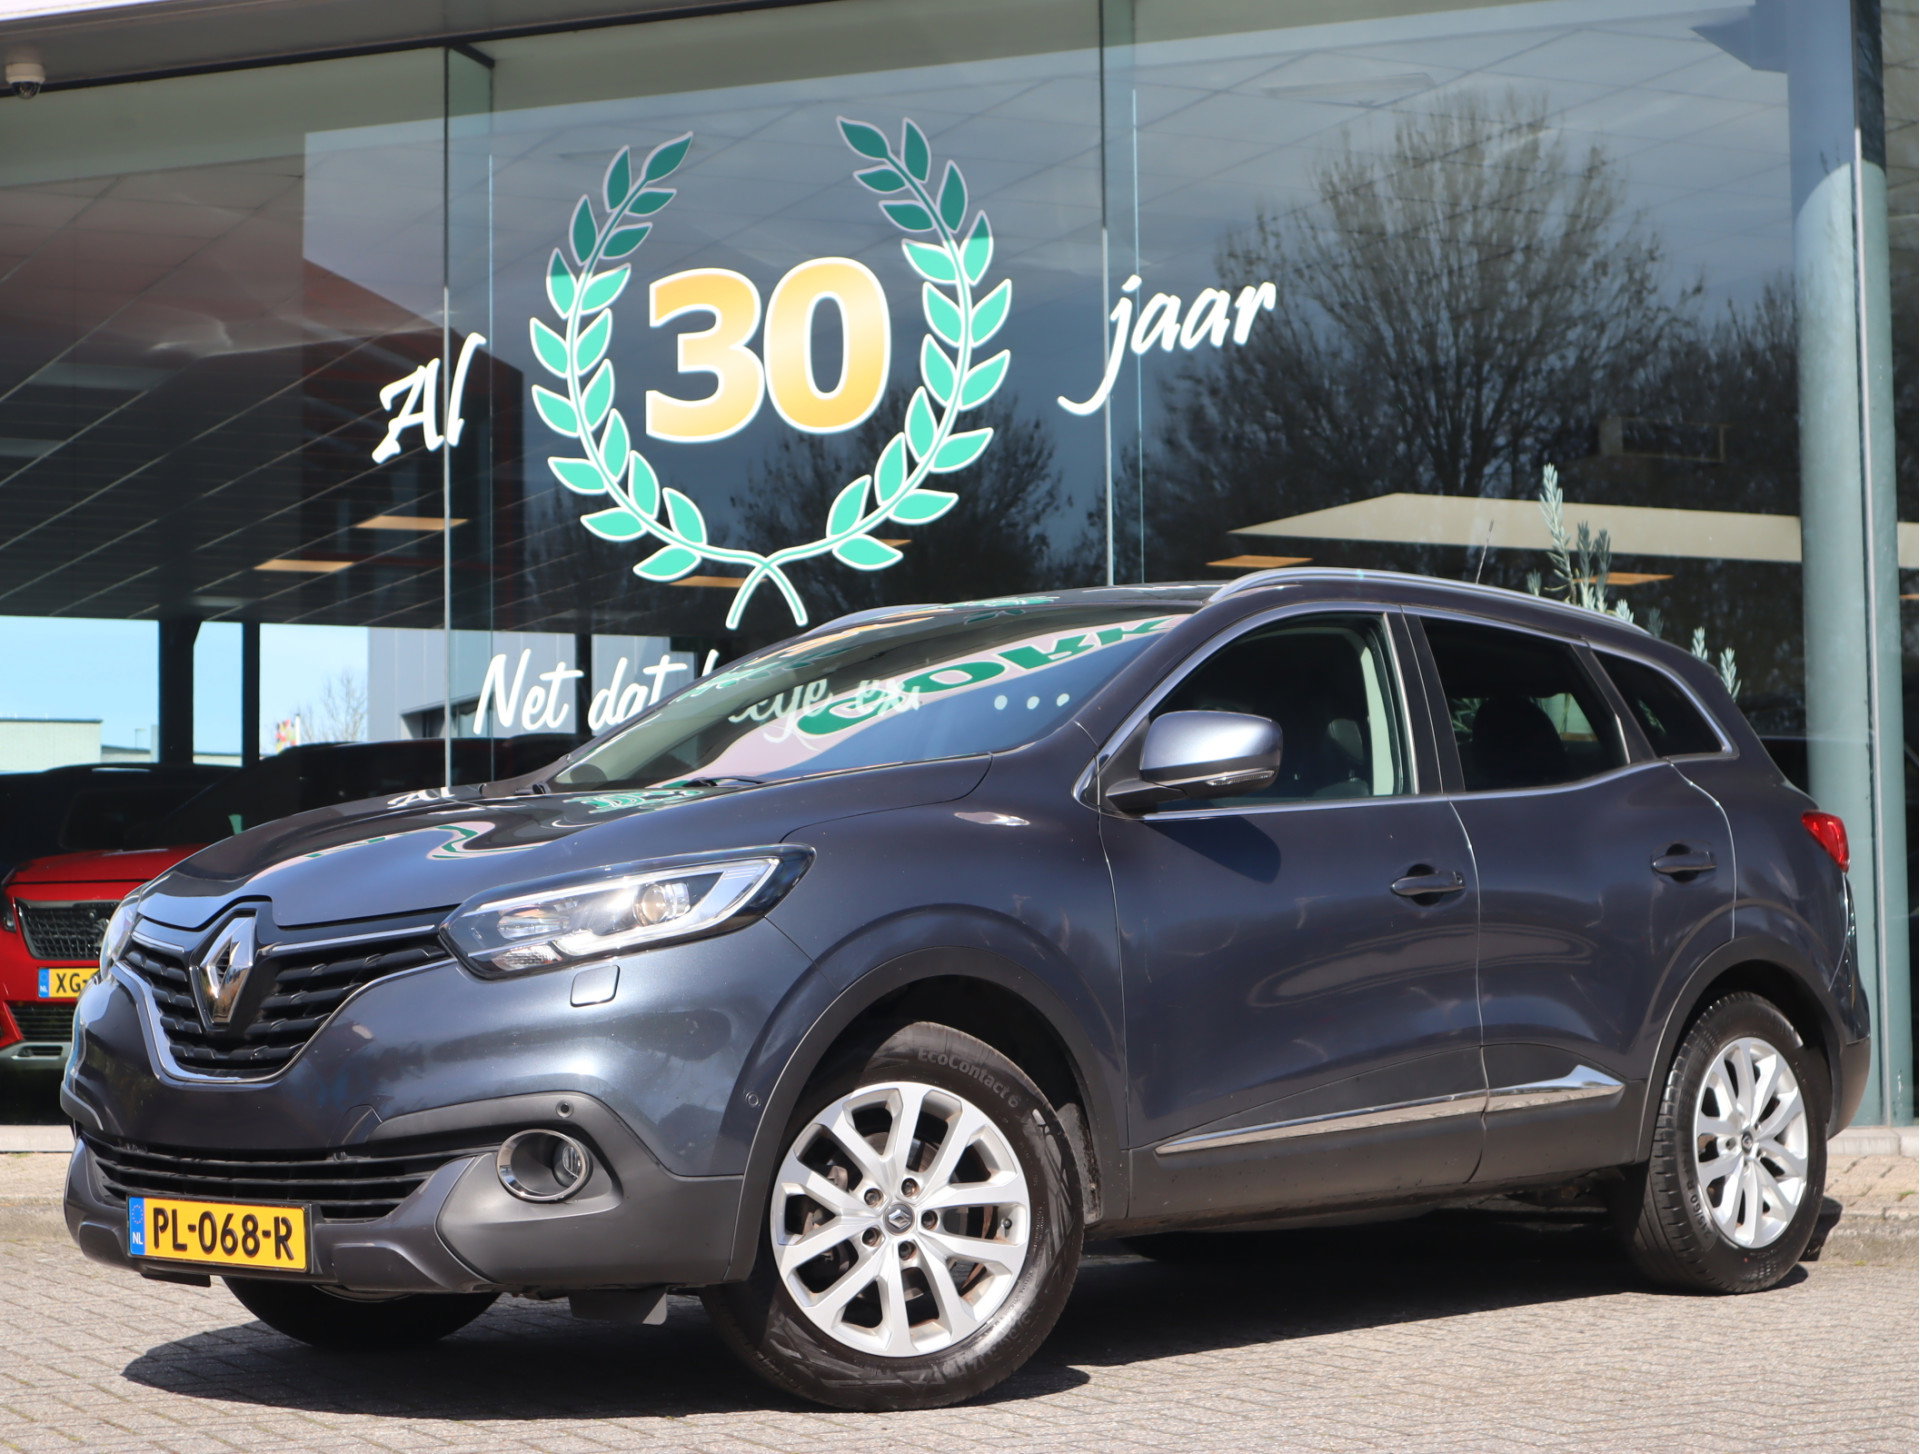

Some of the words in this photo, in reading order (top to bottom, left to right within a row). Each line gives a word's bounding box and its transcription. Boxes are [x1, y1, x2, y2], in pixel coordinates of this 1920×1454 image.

[371, 331, 487, 464] Al
[644, 256, 892, 443] 30
[1057, 274, 1277, 416] jaar
[472, 648, 584, 735] Net
[587, 654, 688, 729] dat
[917, 1047, 1011, 1100] EcoContact
[1007, 1094, 1019, 1108] 6
[132, 1232, 144, 1246] NL
[152, 1206, 295, 1261] PL-068-R
